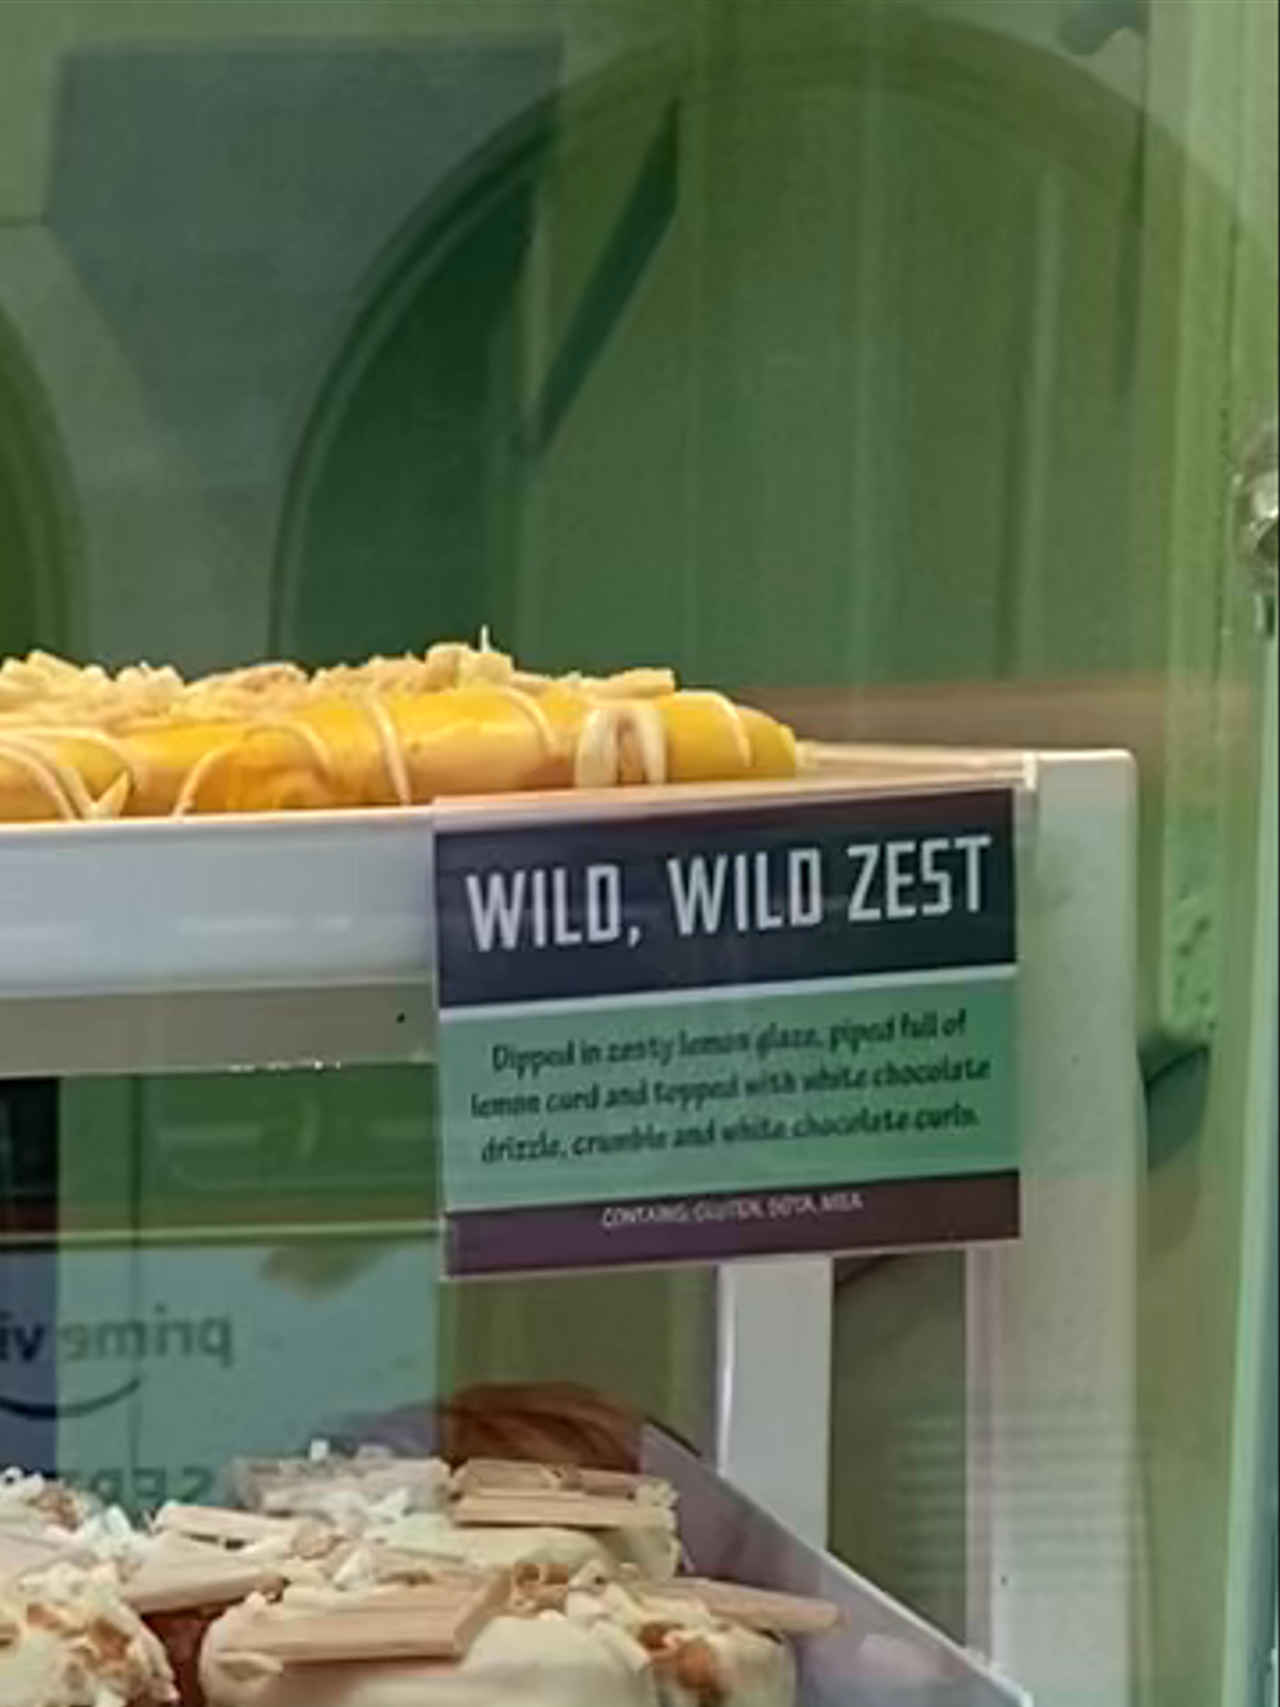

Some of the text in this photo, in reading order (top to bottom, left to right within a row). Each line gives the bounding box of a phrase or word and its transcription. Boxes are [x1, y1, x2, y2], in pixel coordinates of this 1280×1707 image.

[465, 834, 992, 951] WILD, WILD ZEST
[491, 1008, 968, 1079] Dipped in zesty lemon glaze, piped full of
[470, 1054, 992, 1118] lemon curd and topped with white chocolate
[480, 1101, 980, 1165] drizzle, crumble and white chocolate curls.
